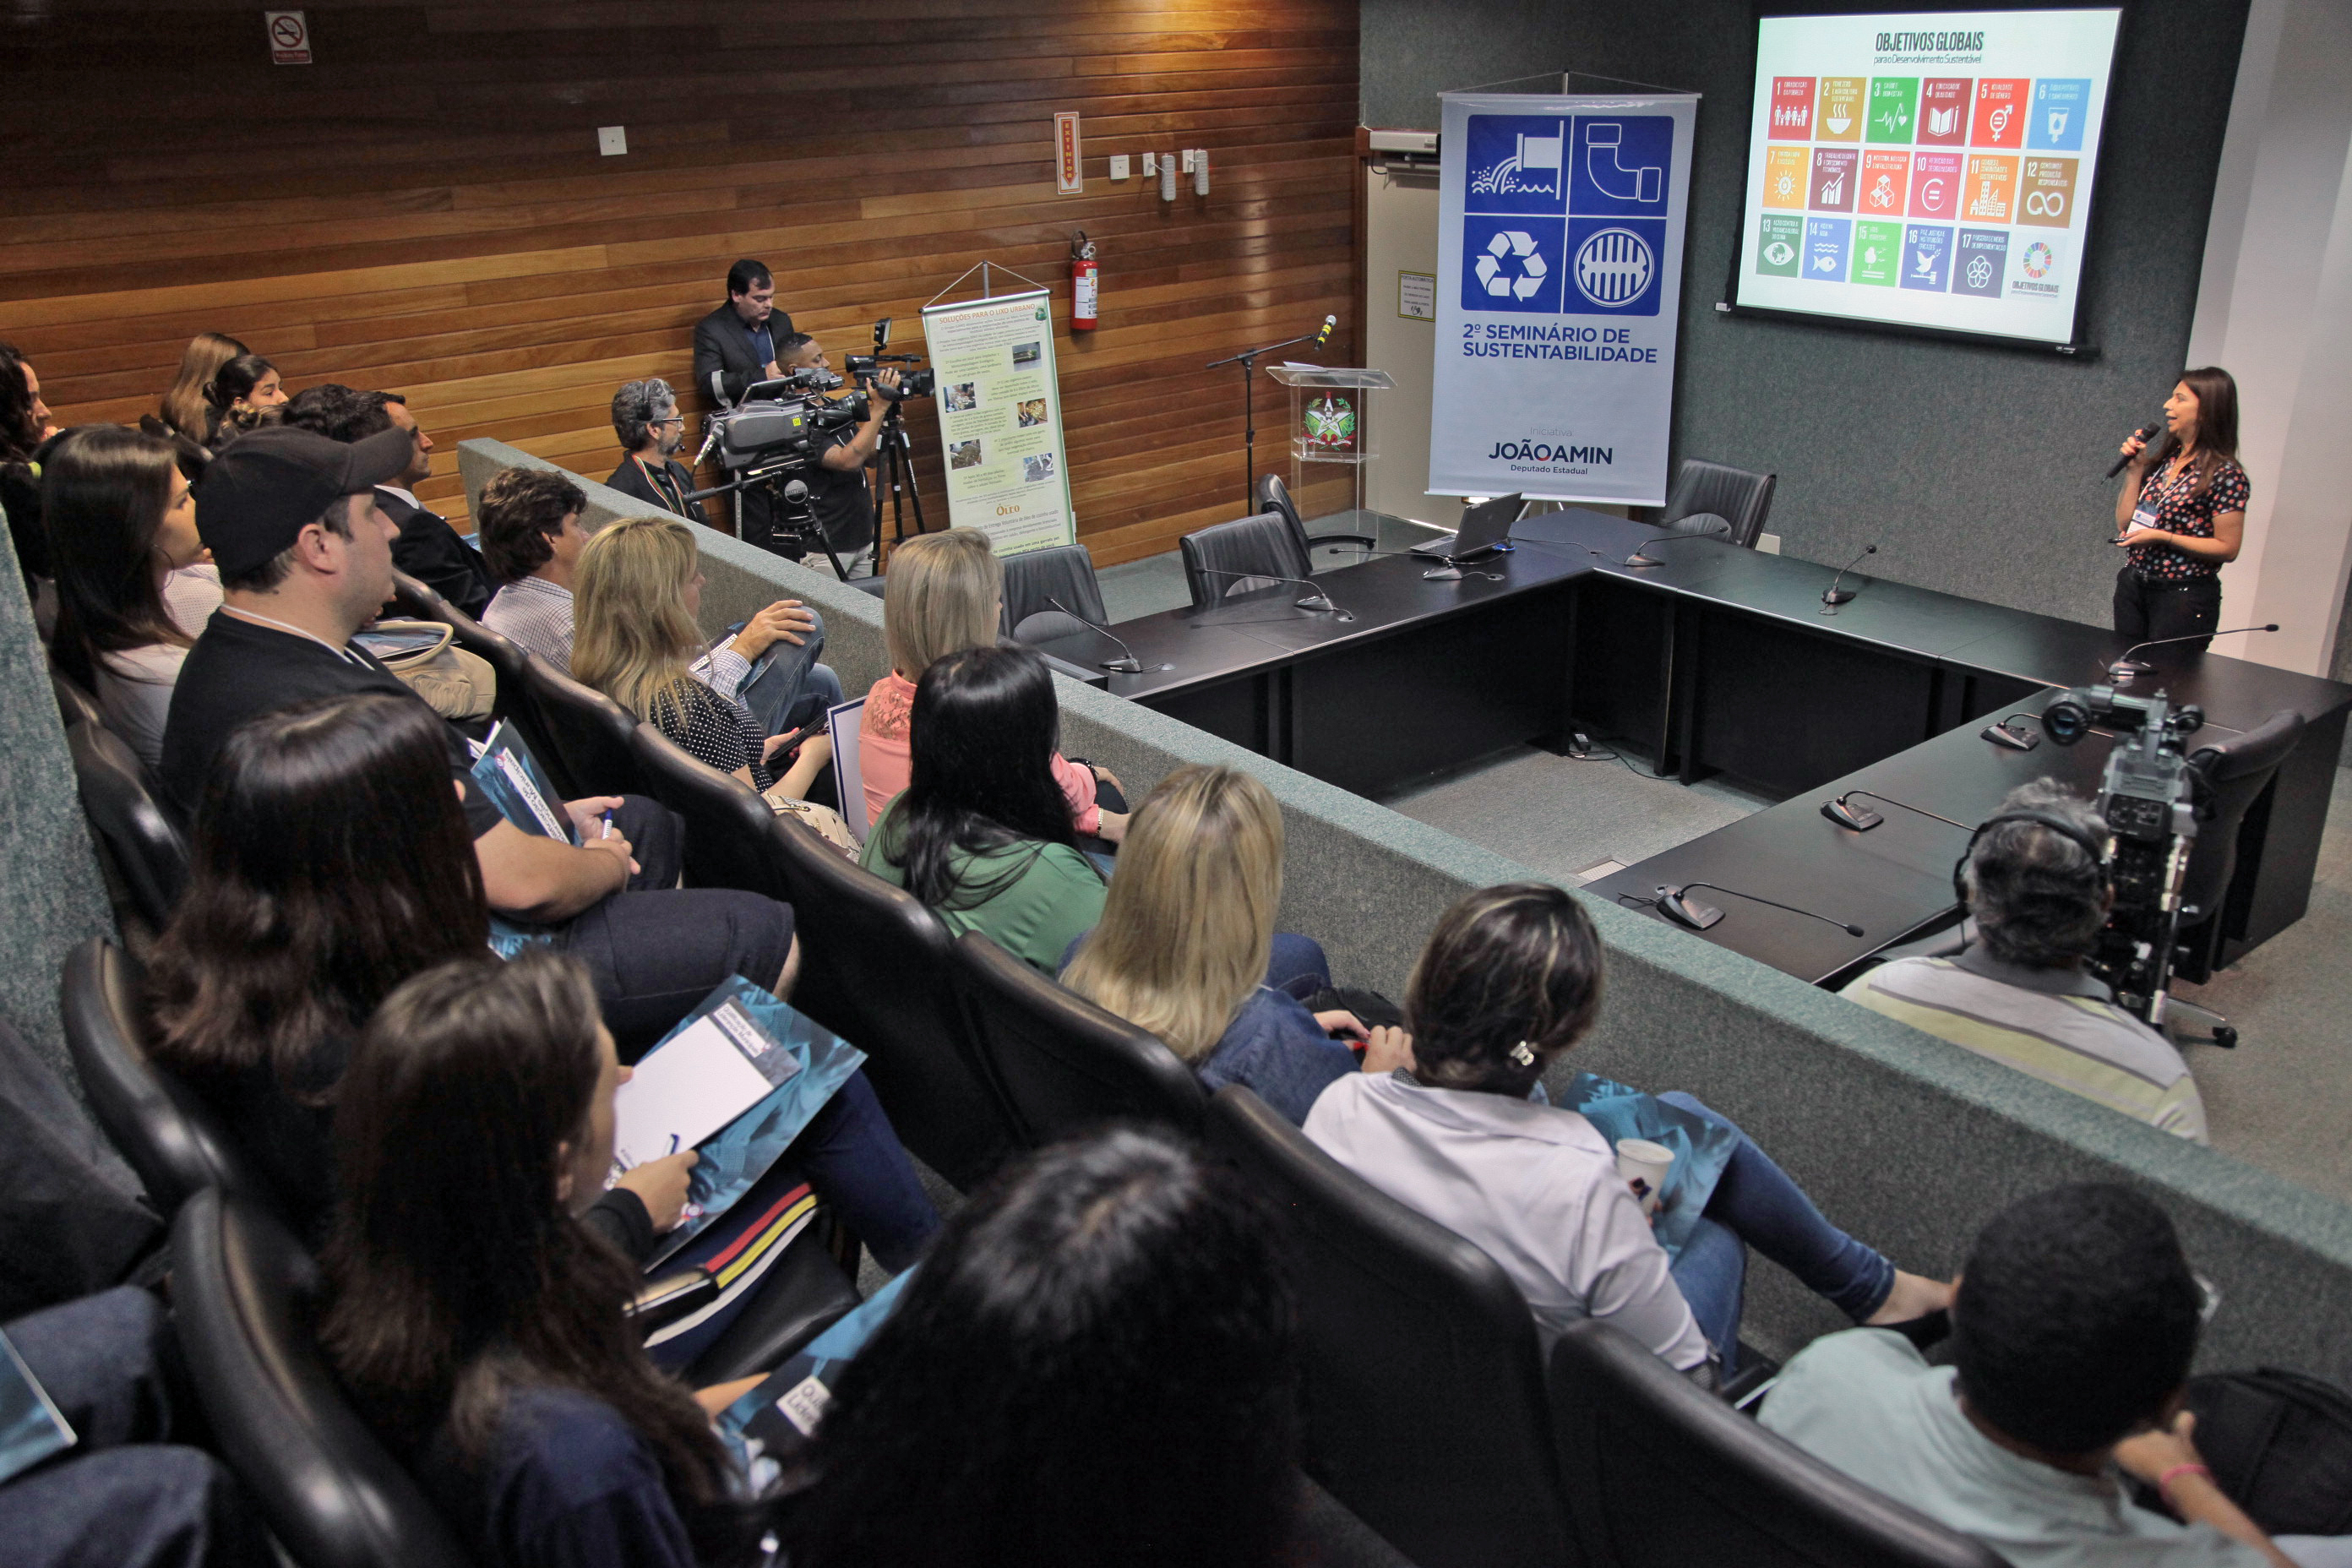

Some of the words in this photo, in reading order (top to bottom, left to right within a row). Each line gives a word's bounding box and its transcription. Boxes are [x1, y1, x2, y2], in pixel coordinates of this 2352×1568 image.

[1875, 32, 1935, 52] OBJETIVOS
[1936, 31, 1984, 52] GLOBAIS
[1874, 57, 1887, 66] para
[1892, 54, 1943, 64] Desenvolvimento
[1944, 54, 1981, 64] Sustentável
[1777, 82, 1781, 95] 1
[1823, 82, 1830, 96] 2
[1874, 82, 1881, 97] 3
[1925, 83, 1933, 98] 4
[1981, 84, 1988, 99] 5
[2039, 84, 2046, 100] 6
[1064, 122, 1073, 178] EXTINTOR
[1770, 150, 1775, 164] 7
[1816, 152, 1822, 166] 8
[1865, 155, 1872, 169] 9
[1917, 156, 1927, 172] 10
[1971, 159, 1979, 174] 11
[2027, 161, 2038, 177] 12
[1762, 219, 1771, 232] 13
[1810, 222, 1818, 236] 14
[1858, 226, 1868, 240] 15
[1908, 229, 1918, 243] 16
[1962, 234, 1972, 248] 17
[2012, 280, 2038, 291] OBJETIVOS
[2039, 283, 2060, 293] GLOBAIS
[939, 313, 971, 324] SOLUÇÕES
[972, 311, 988, 319] PARA
[1010, 303, 1036, 313] URBANO
[1462, 324, 1481, 339] 2º
[1486, 323, 1598, 342] SEMINÁRIO
[1603, 328, 1631, 344] DE
[1462, 341, 1658, 363] SUSTENTABILIDADE
[1511, 465, 1551, 474] Deputado
[1553, 466, 1588, 475] Estadual
[504, 751, 537, 800] Municipais
[522, 787, 531, 799] de
[530, 798, 558, 841] alificação
[536, 798, 566, 842] ideranças
